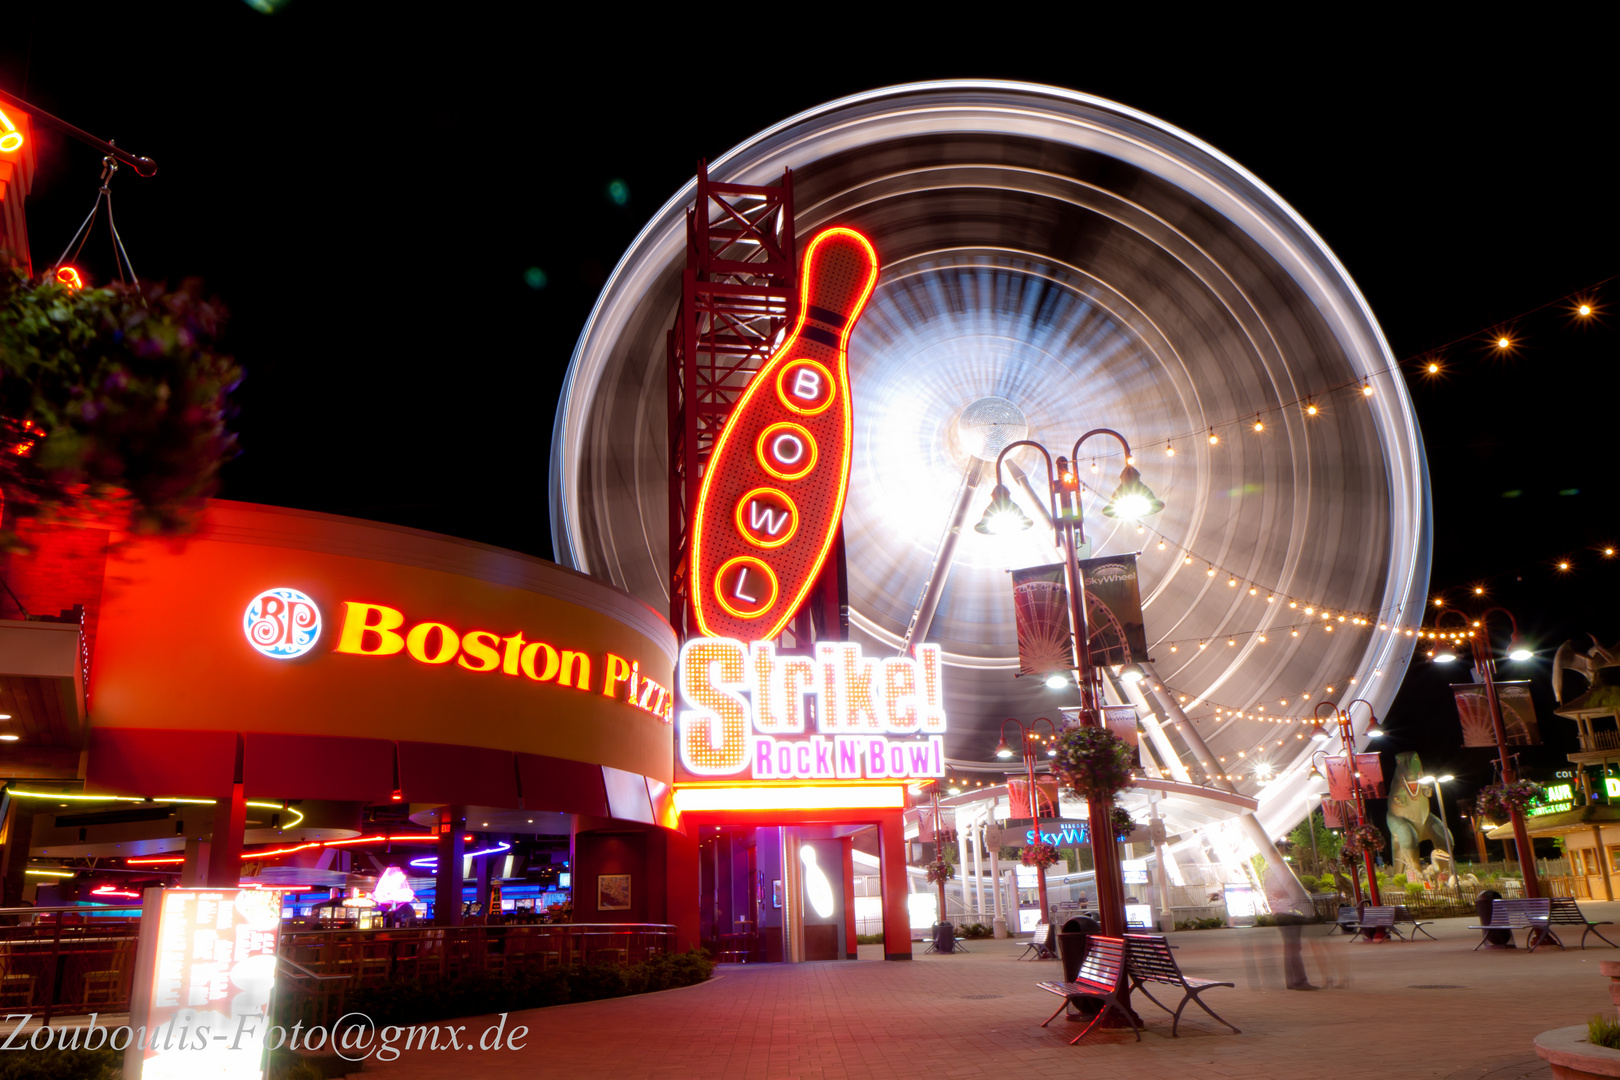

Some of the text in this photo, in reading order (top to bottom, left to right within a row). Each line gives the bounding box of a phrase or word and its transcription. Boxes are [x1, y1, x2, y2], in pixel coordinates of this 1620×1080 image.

[734, 368, 820, 603] BOWL
[1085, 572, 1136, 586] SkyWheel
[250, 595, 317, 645] BP
[333, 601, 673, 724] Boston Pizza
[681, 638, 945, 774] Strike!
[756, 739, 830, 775] Rock
[869, 738, 942, 775] Bowl
[1555, 802, 1572, 812] GOLF
